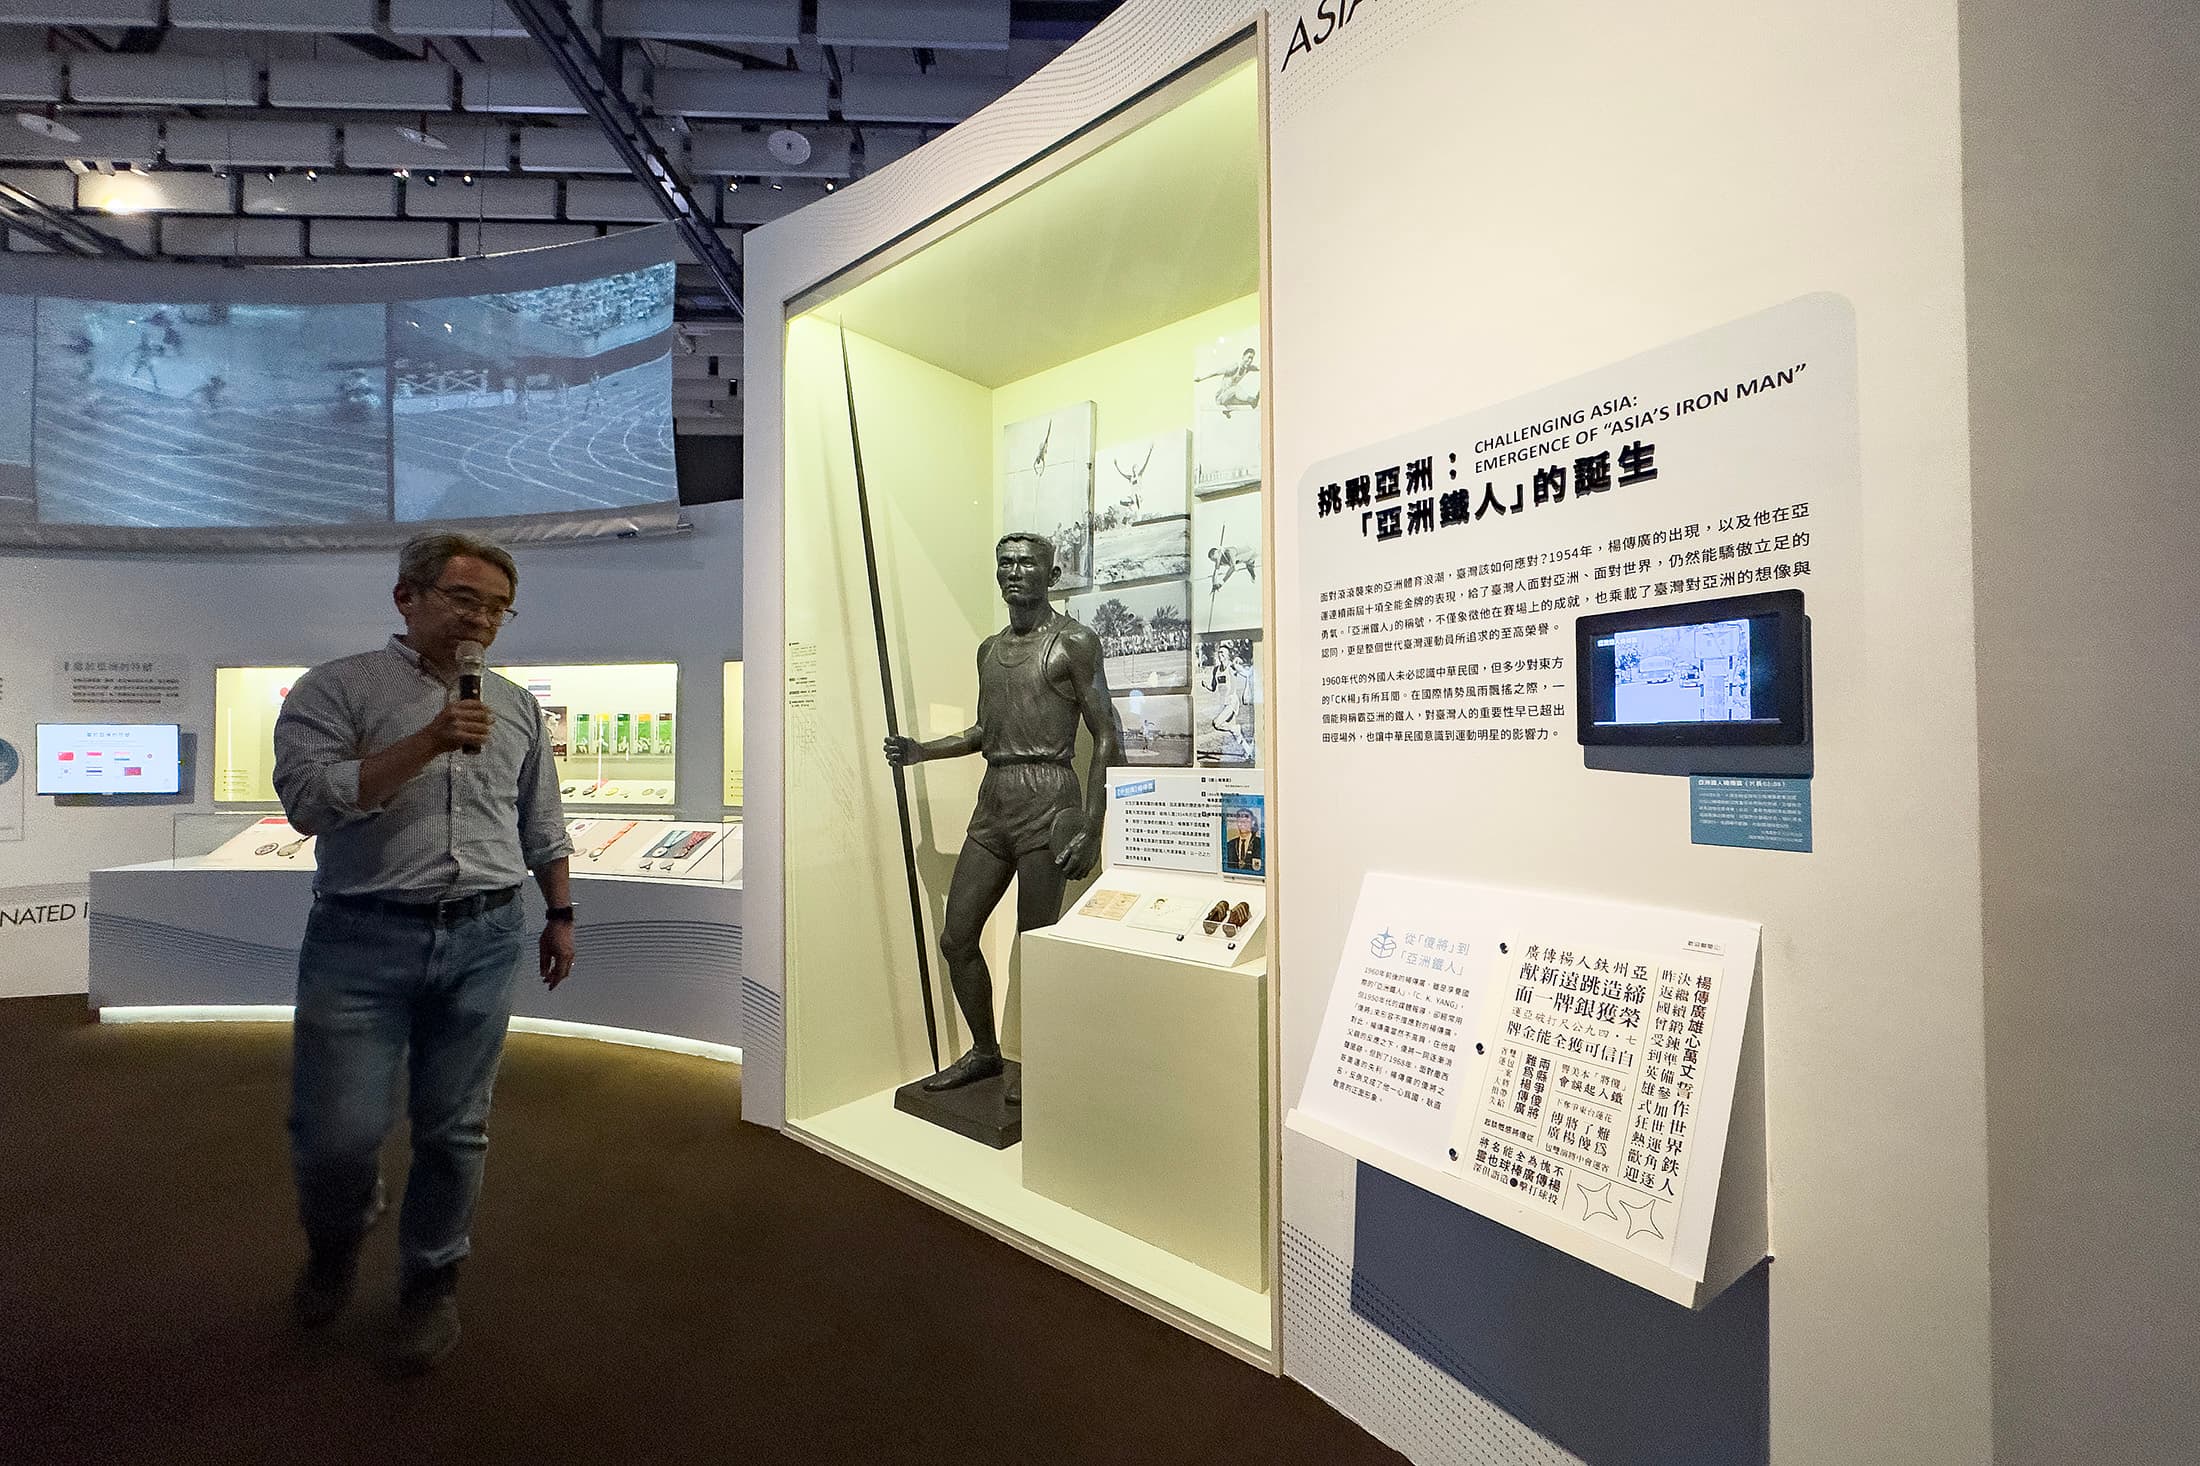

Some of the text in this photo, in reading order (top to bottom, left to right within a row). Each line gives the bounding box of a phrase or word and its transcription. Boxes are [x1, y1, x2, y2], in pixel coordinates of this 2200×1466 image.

[1474, 396, 1638, 454] CHALLENGING ASIA:
[1475, 435, 1570, 474] EMERGENCE
[1576, 427, 1598, 445] OF
[1676, 388, 1729, 417] IRON
[1361, 440, 1658, 542] 「亞洲鐵人」的誕生
